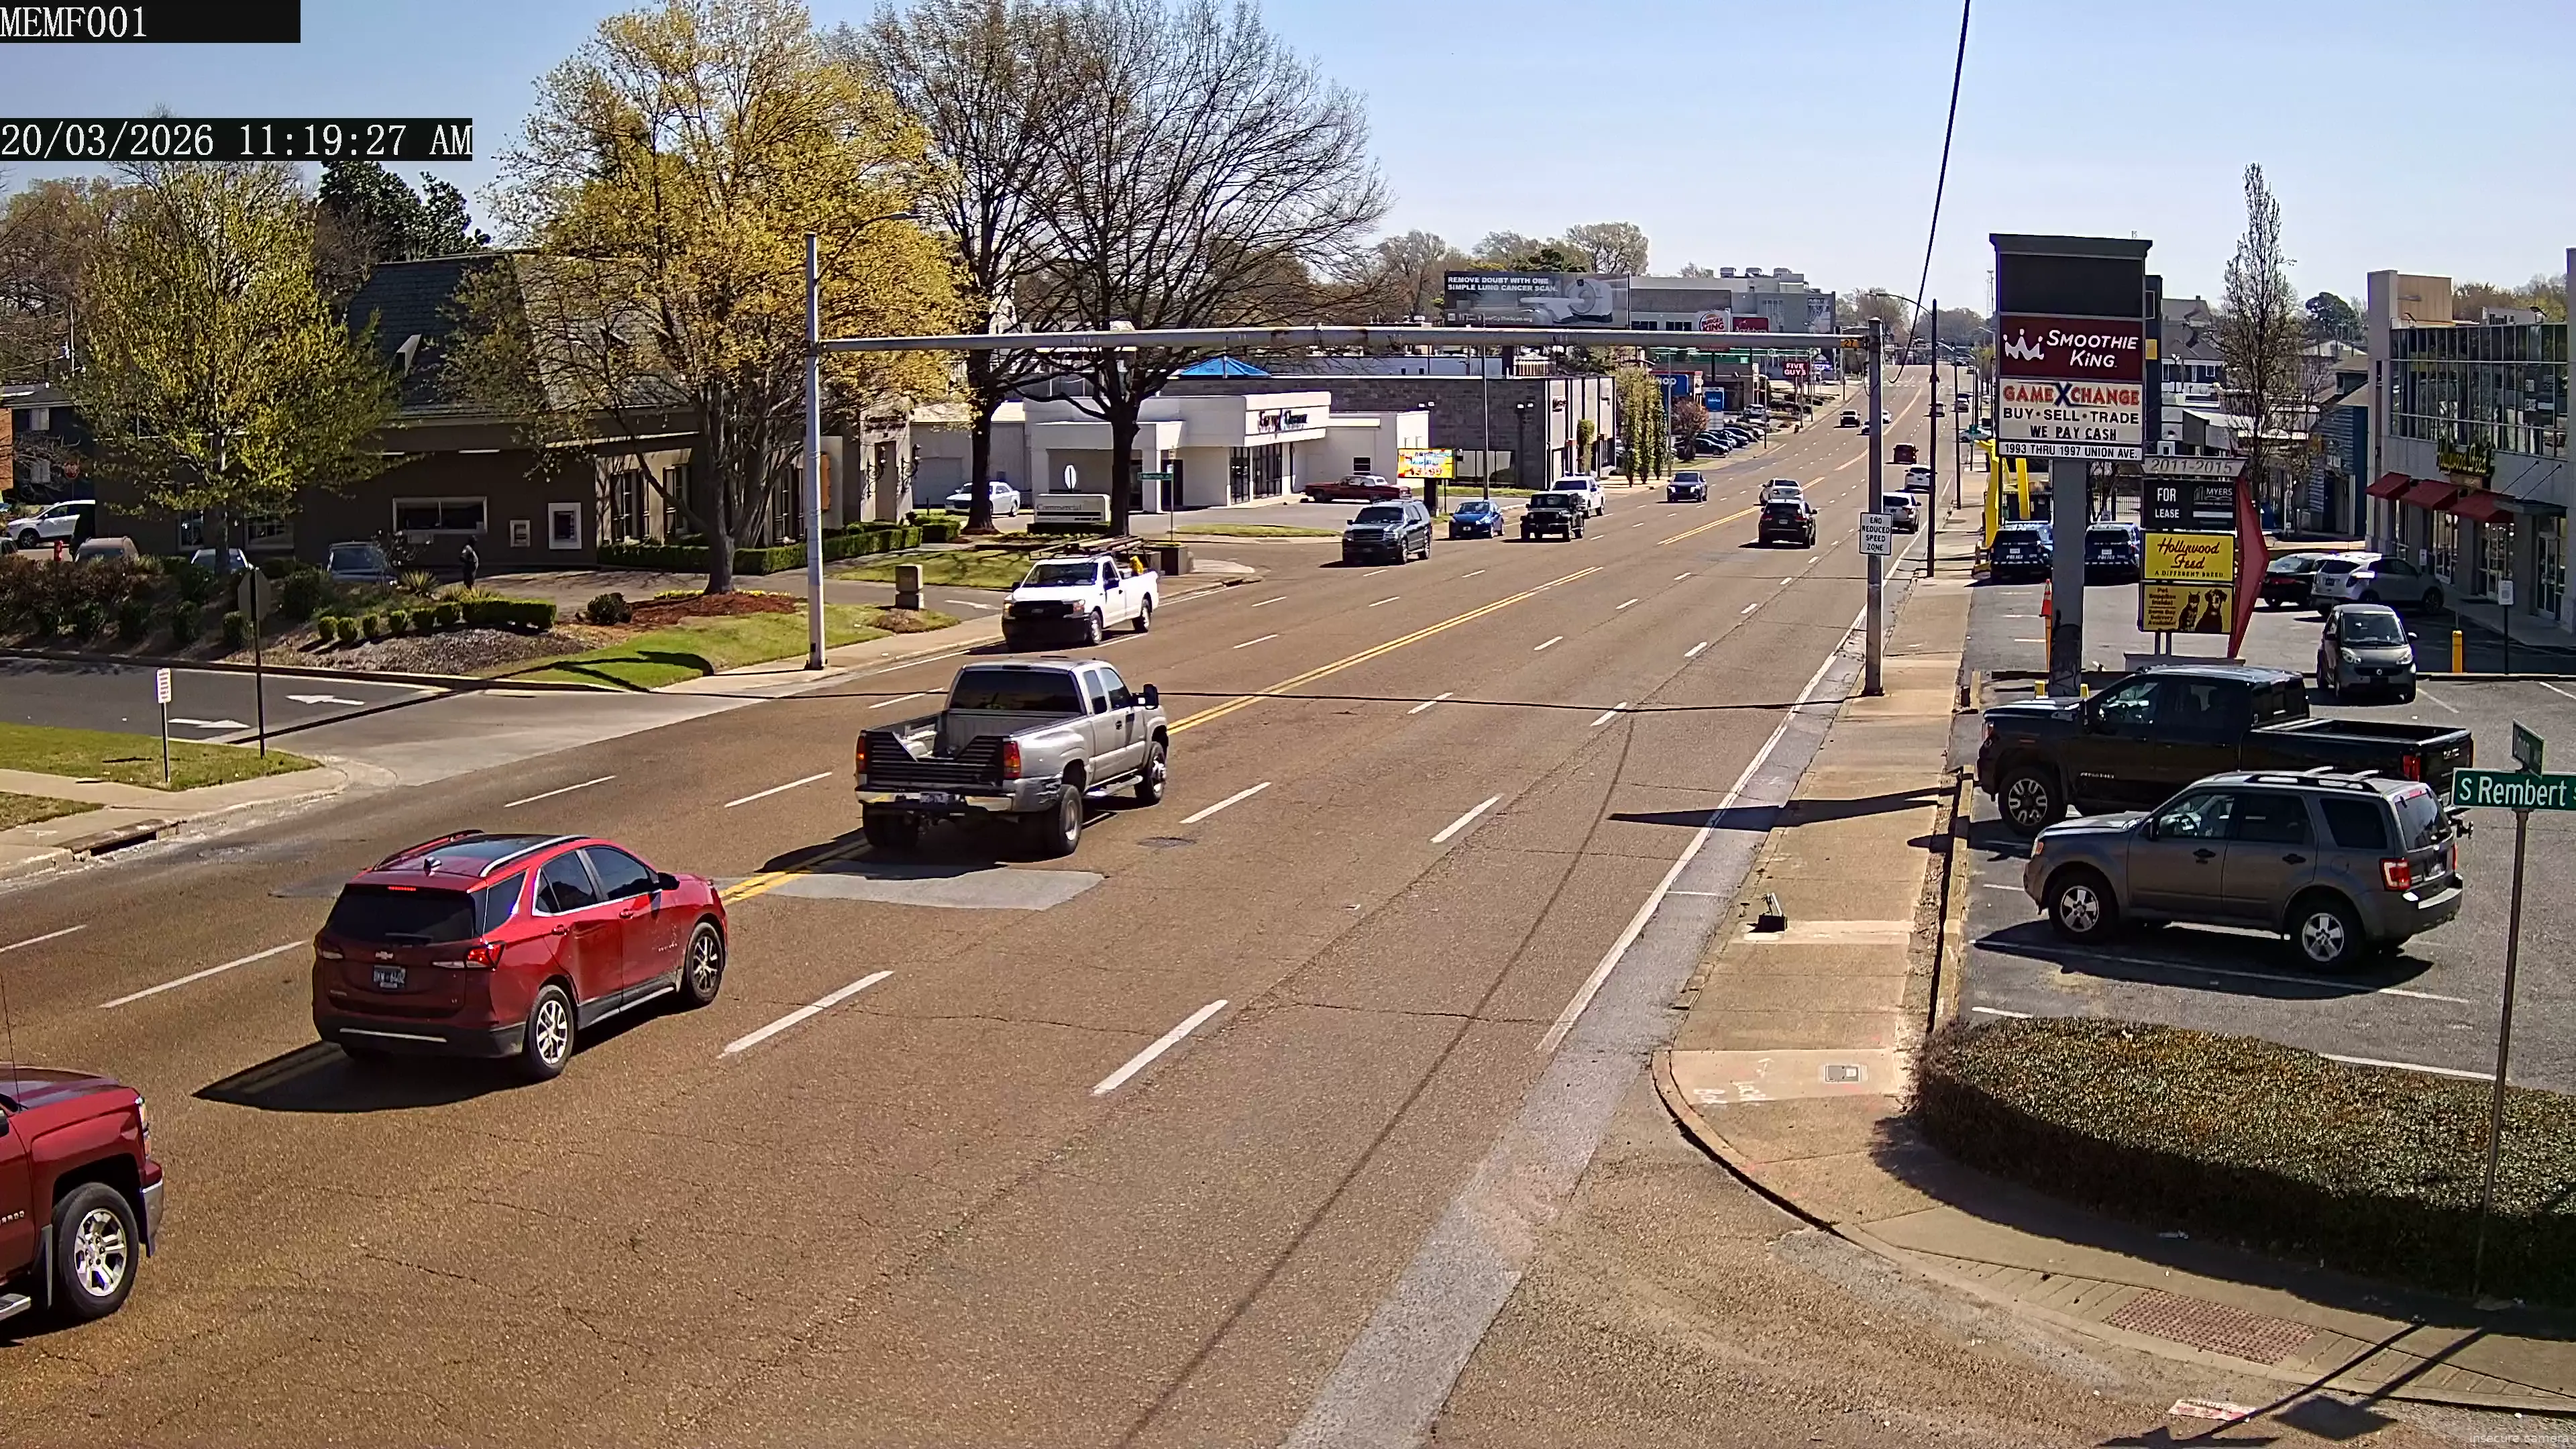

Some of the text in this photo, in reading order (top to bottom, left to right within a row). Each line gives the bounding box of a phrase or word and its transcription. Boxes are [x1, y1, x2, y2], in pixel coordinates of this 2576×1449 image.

[2047, 329, 2139, 350] SMOOTHIE
[2003, 407, 2139, 424] BUY SELL TRADE
[2030, 425, 2116, 440] WE PAY CASH
[2004, 443, 2137, 459] 1993 THRU 1997 UNION AVE.
[2151, 459, 2233, 474] 2011-2015
[2157, 488, 2176, 502] FOR
[2206, 488, 2233, 496] MYERS
[2155, 508, 2180, 519] LEASE
[1862, 525, 1890, 533] REDUCED
[1866, 543, 1884, 551] ZONE
[2157, 537, 2220, 555] Hollywood
[2171, 554, 2206, 570] Feed
[2459, 777, 2472, 801] S
[2477, 775, 2567, 807] Rembert
